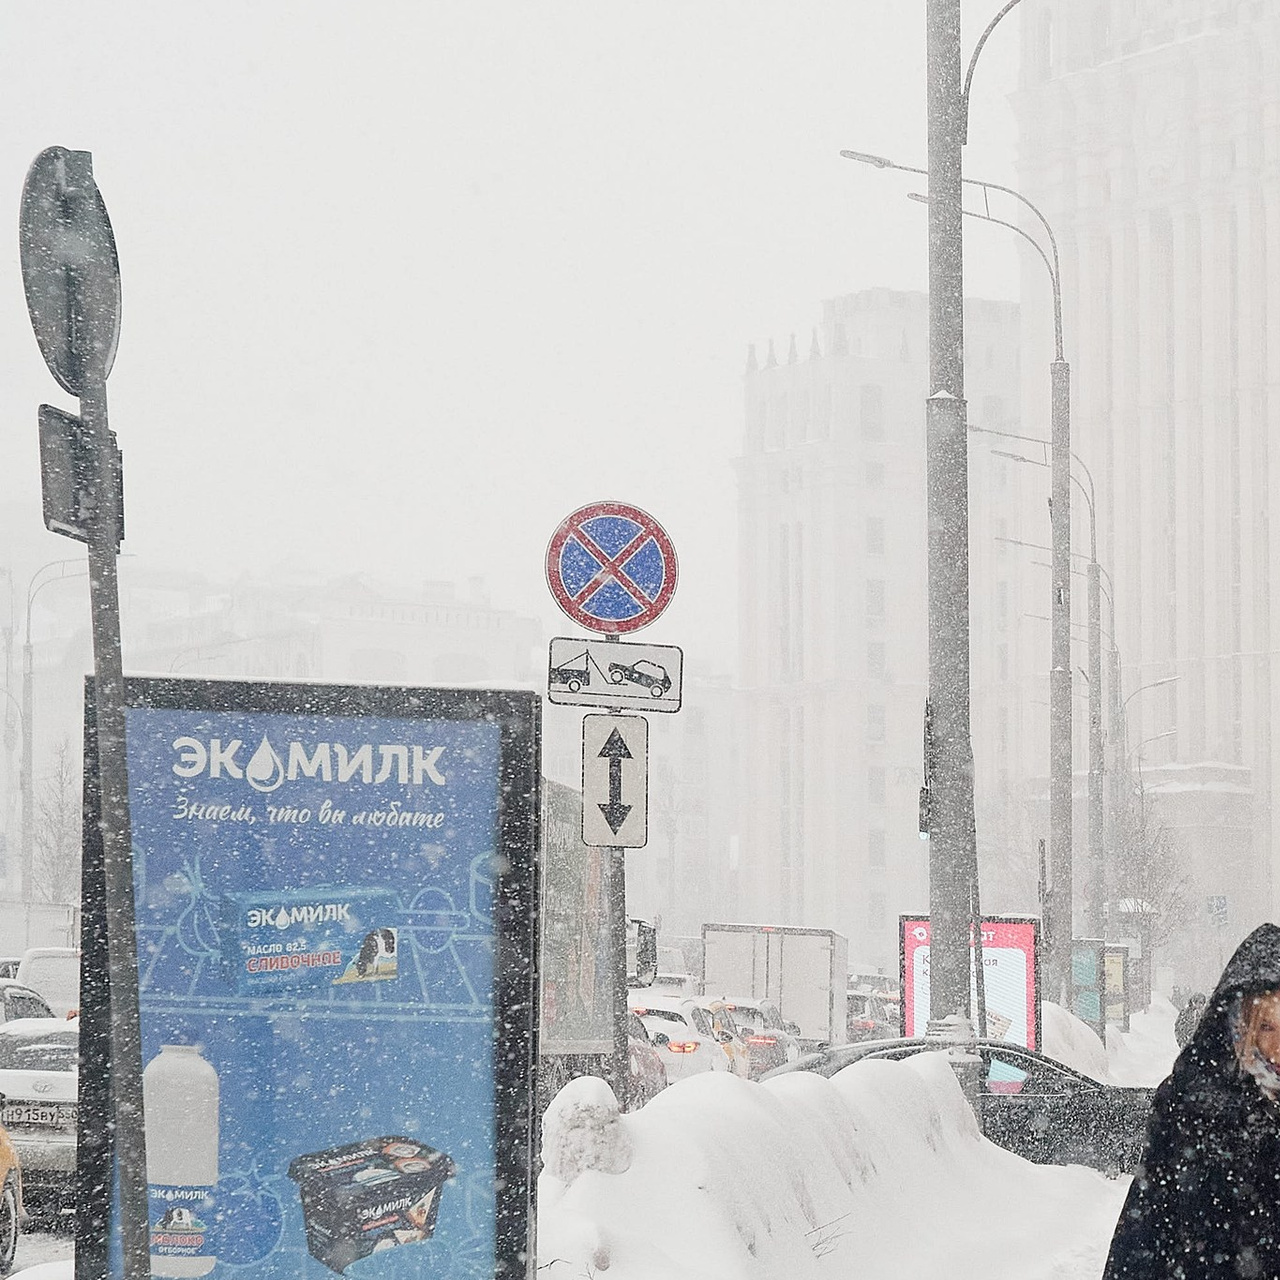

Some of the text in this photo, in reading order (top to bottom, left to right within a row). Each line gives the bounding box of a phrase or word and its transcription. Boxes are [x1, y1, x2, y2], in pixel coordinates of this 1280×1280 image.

[173, 796, 445, 828] Знаем, что вы любите
[247, 943, 283, 955] МАСЛО
[246, 951, 342, 974] СЛИВОЧНОЕ
